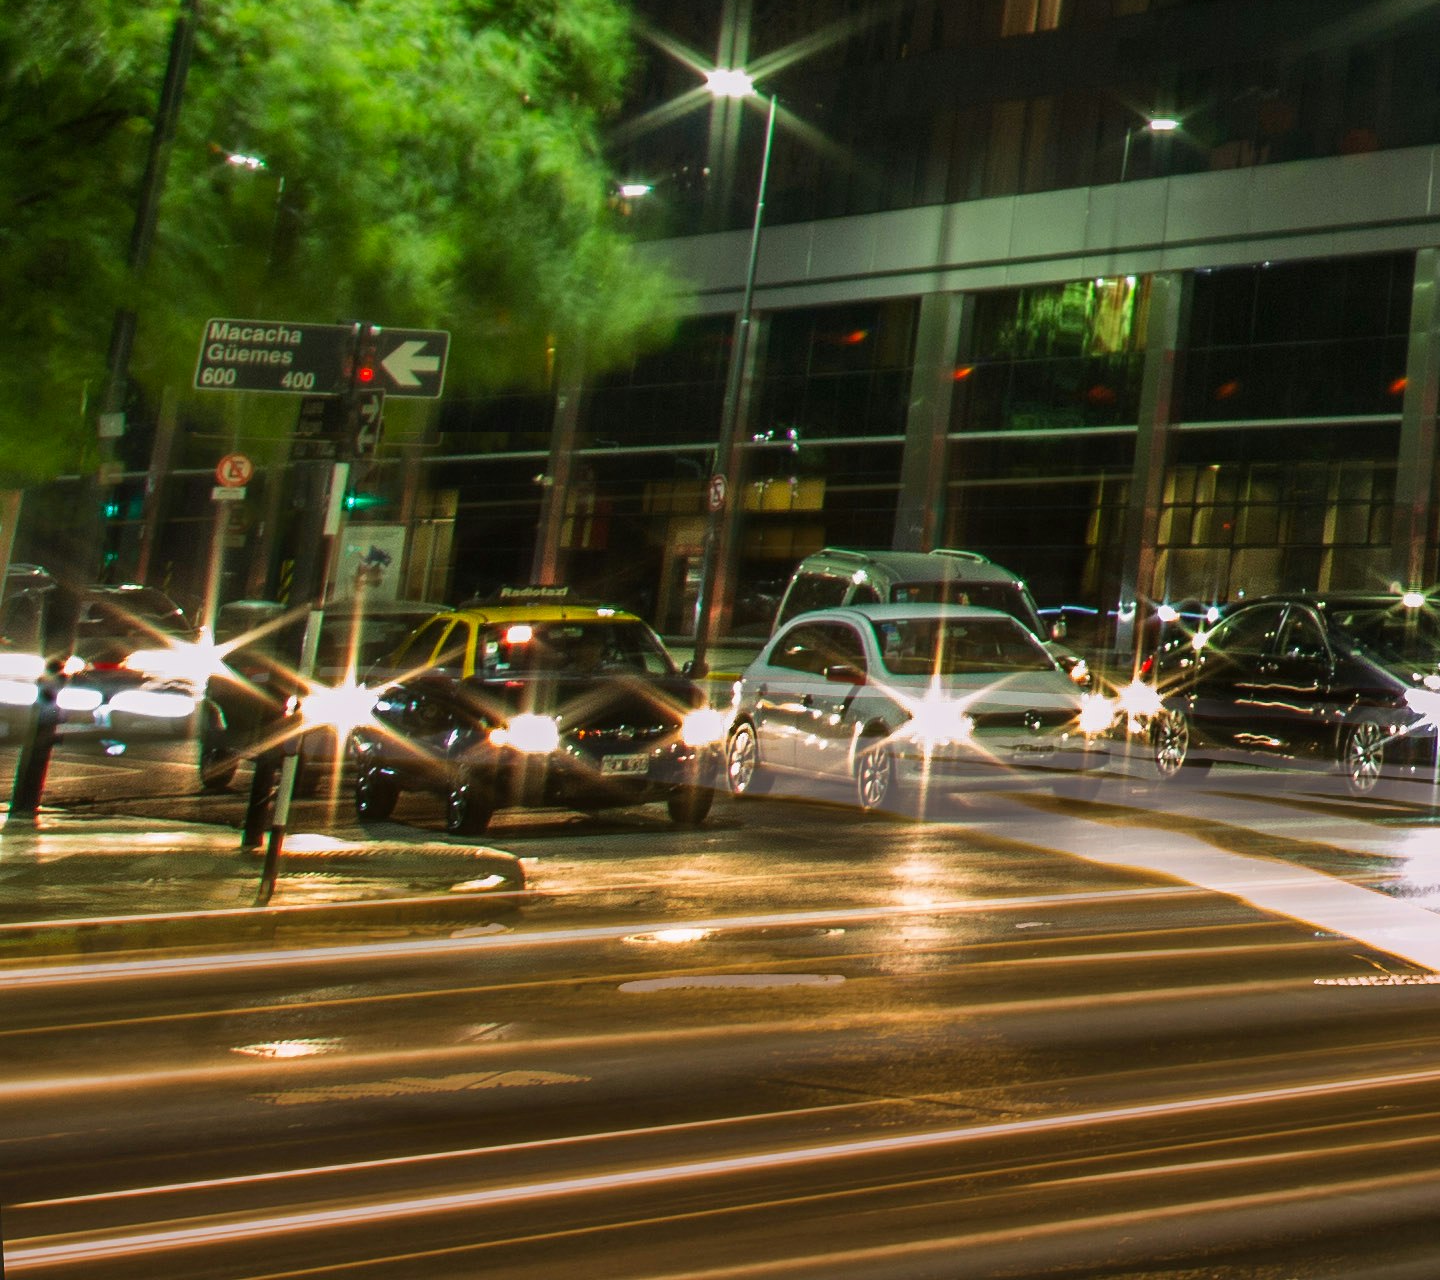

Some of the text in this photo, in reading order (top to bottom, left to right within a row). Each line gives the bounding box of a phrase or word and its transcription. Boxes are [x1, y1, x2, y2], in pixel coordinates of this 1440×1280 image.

[208, 322, 302, 344] Macacha
[206, 343, 293, 365] Güemes
[201, 367, 316, 390] 600 400
[500, 586, 569, 598] Radiotaxi
